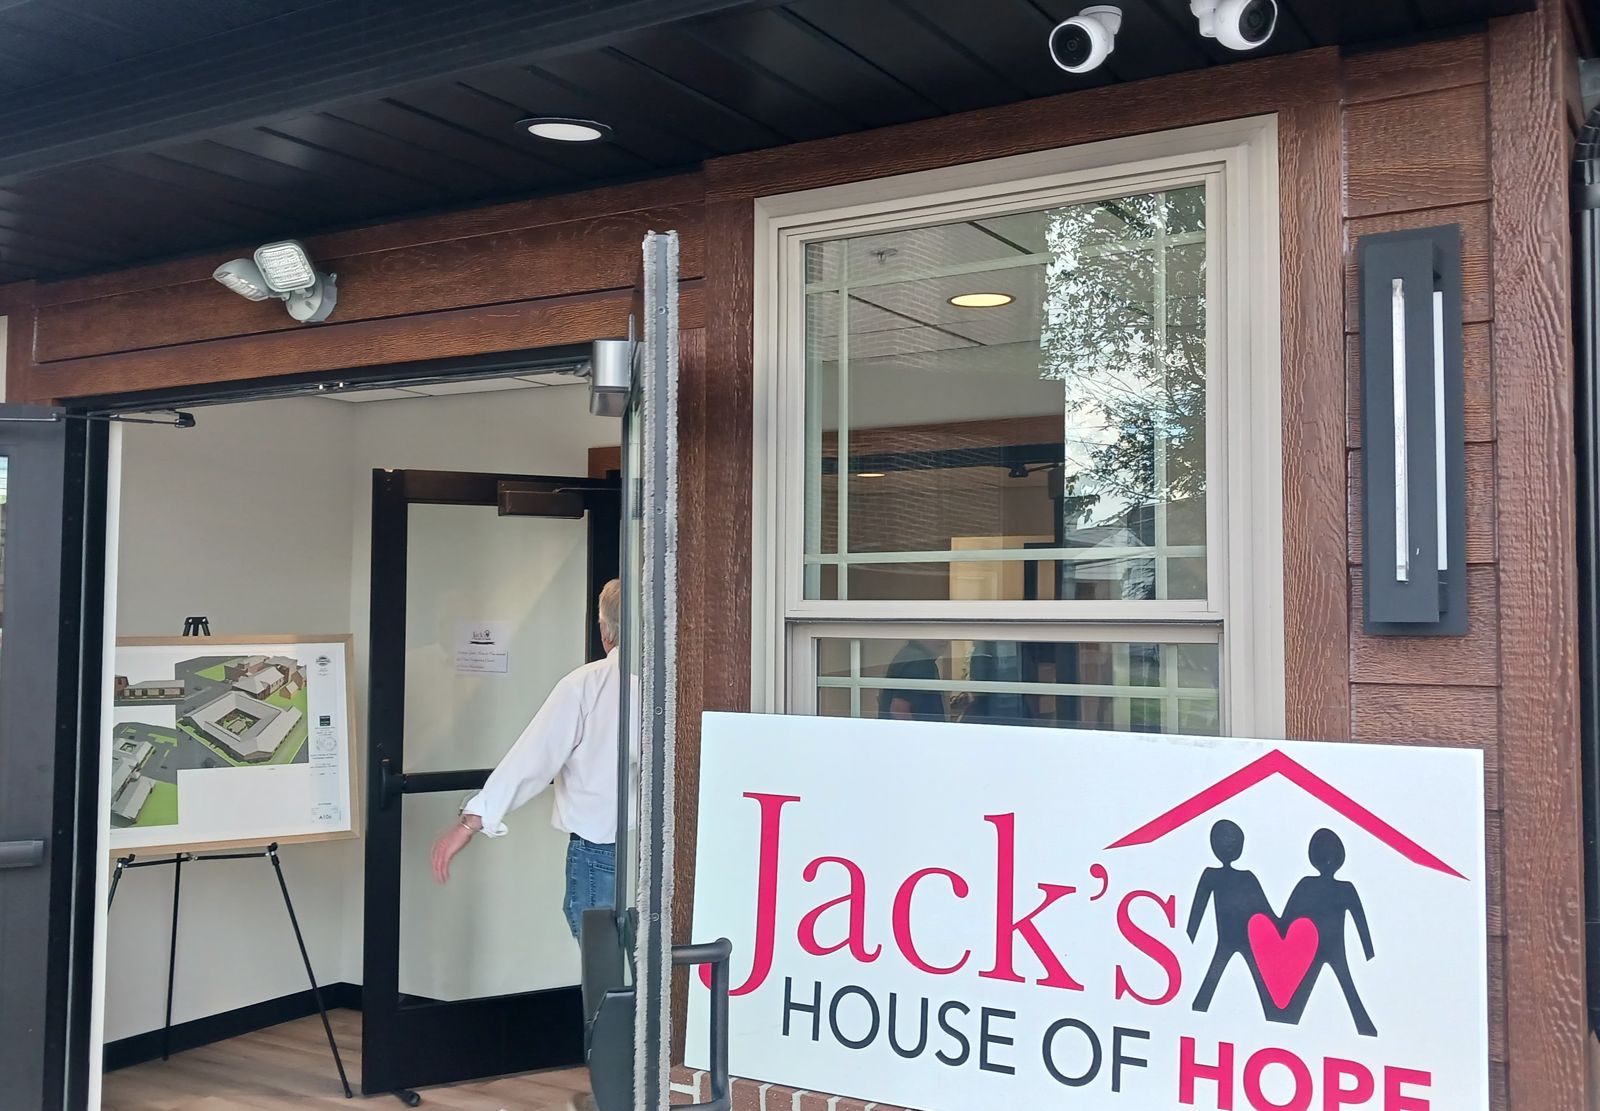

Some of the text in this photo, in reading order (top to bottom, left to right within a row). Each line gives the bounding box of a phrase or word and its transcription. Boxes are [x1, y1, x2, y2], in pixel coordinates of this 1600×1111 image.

[699, 792, 1182, 1006] Jack's
[782, 975, 1016, 1076] HOUSE
[1042, 1017, 1151, 1093] OF
